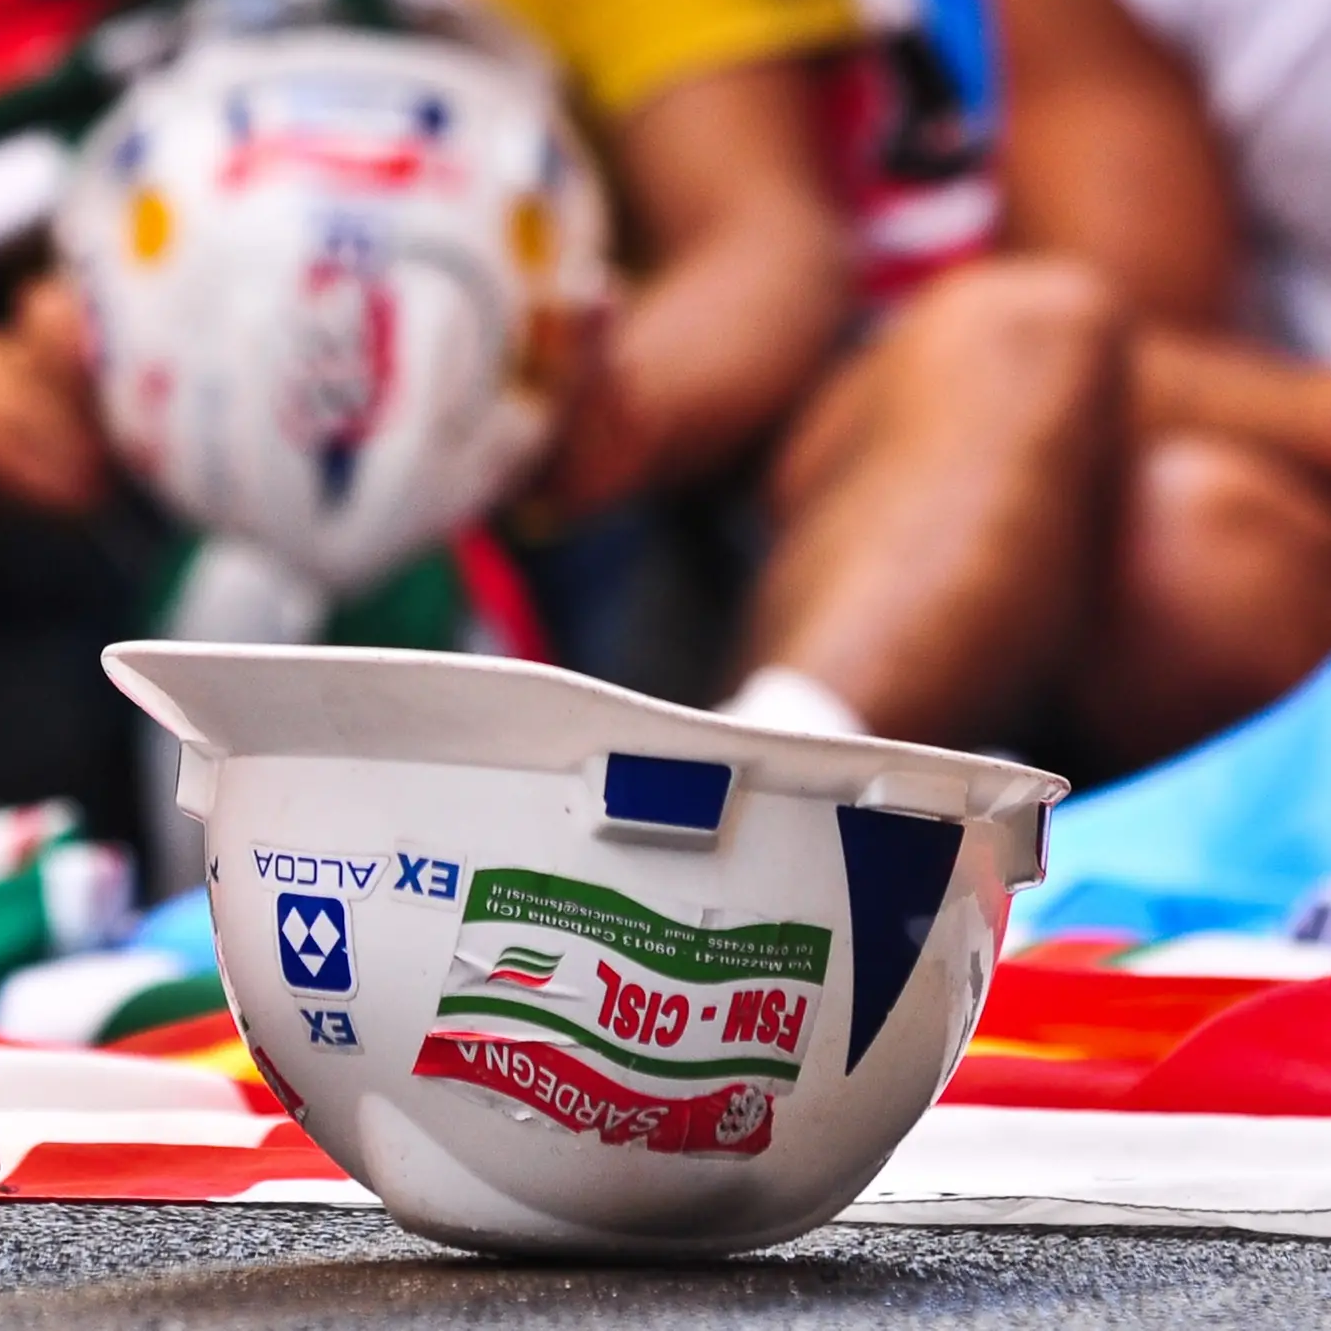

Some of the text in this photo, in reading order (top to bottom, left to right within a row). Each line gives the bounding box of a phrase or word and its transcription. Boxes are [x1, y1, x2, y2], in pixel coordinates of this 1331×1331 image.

[253, 850, 377, 890] ALCOA
[394, 853, 460, 901] EX
[528, 911, 616, 943] Carbonia
[622, 935, 677, 957] 09013
[788, 960, 813, 971] Via
[596, 960, 690, 1049] CISL
[720, 988, 808, 1055] FSM
[299, 1009, 358, 1047] EX
[454, 1041, 670, 1135] SARDEGNA
